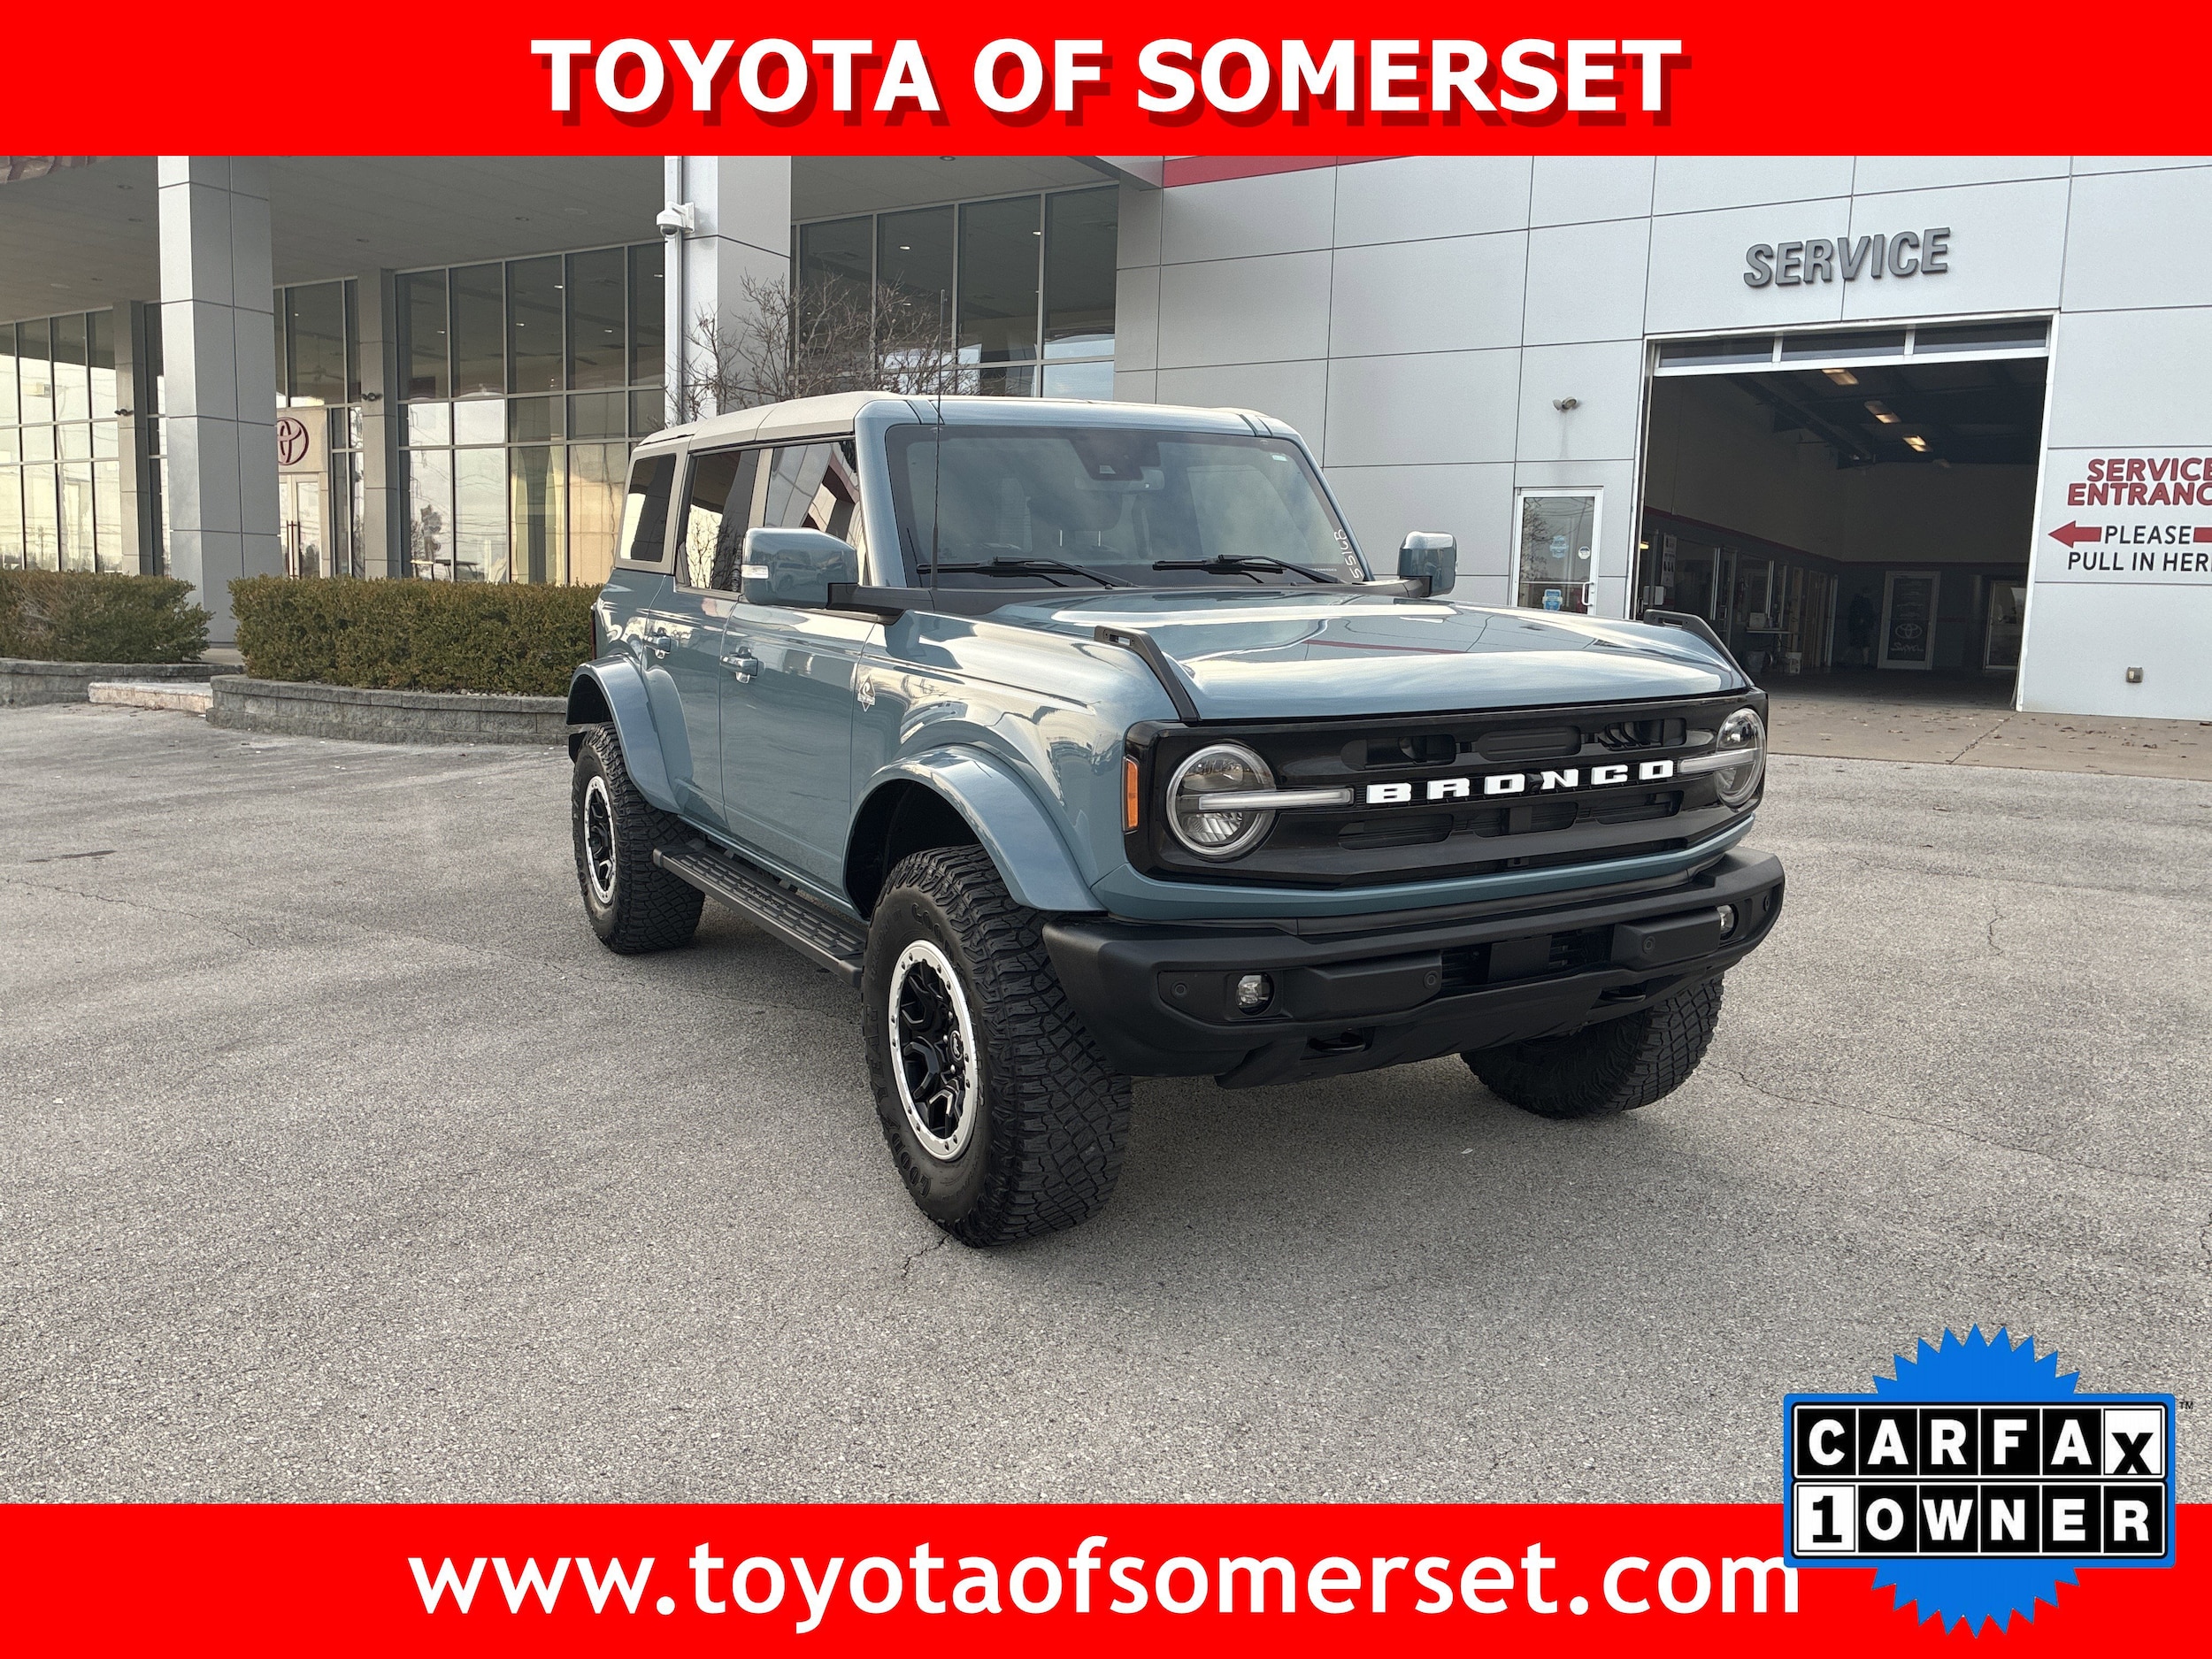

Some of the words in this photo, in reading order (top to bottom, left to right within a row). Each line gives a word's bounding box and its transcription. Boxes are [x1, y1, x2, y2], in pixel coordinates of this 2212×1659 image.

[1743, 227, 1951, 288] SERVICE
[2067, 482, 2212, 506] ENTRANC
[2104, 525, 2193, 545] PLEASE
[2067, 551, 2124, 571] PULL
[2131, 552, 2155, 572] IN
[2162, 552, 2212, 572] HER
[1365, 759, 1676, 804] BRONCO
